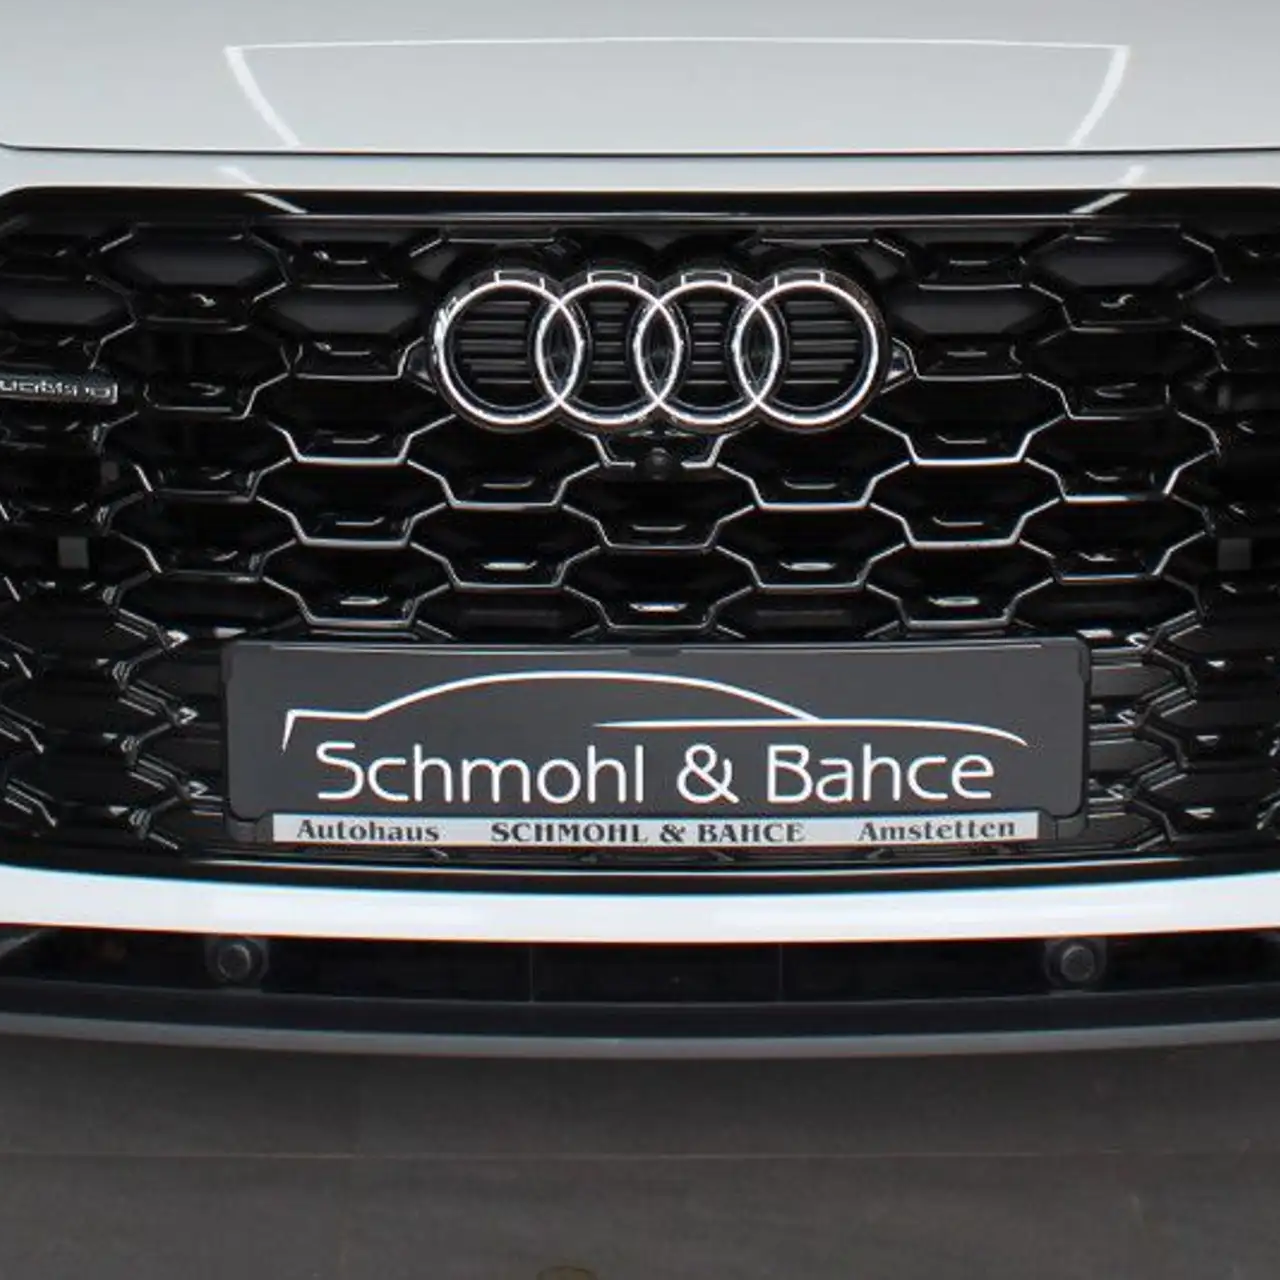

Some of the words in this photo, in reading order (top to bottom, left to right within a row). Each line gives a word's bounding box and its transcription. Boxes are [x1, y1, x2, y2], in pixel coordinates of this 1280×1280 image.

[315, 740, 645, 804] Schmohl
[675, 742, 741, 804] &
[765, 742, 996, 804] Bahce
[296, 817, 441, 843] Autohaus
[490, 822, 650, 843] SCHMOHL
[658, 823, 688, 844] &
[696, 822, 806, 843] BAHCE
[857, 819, 1017, 843] Amstetten
